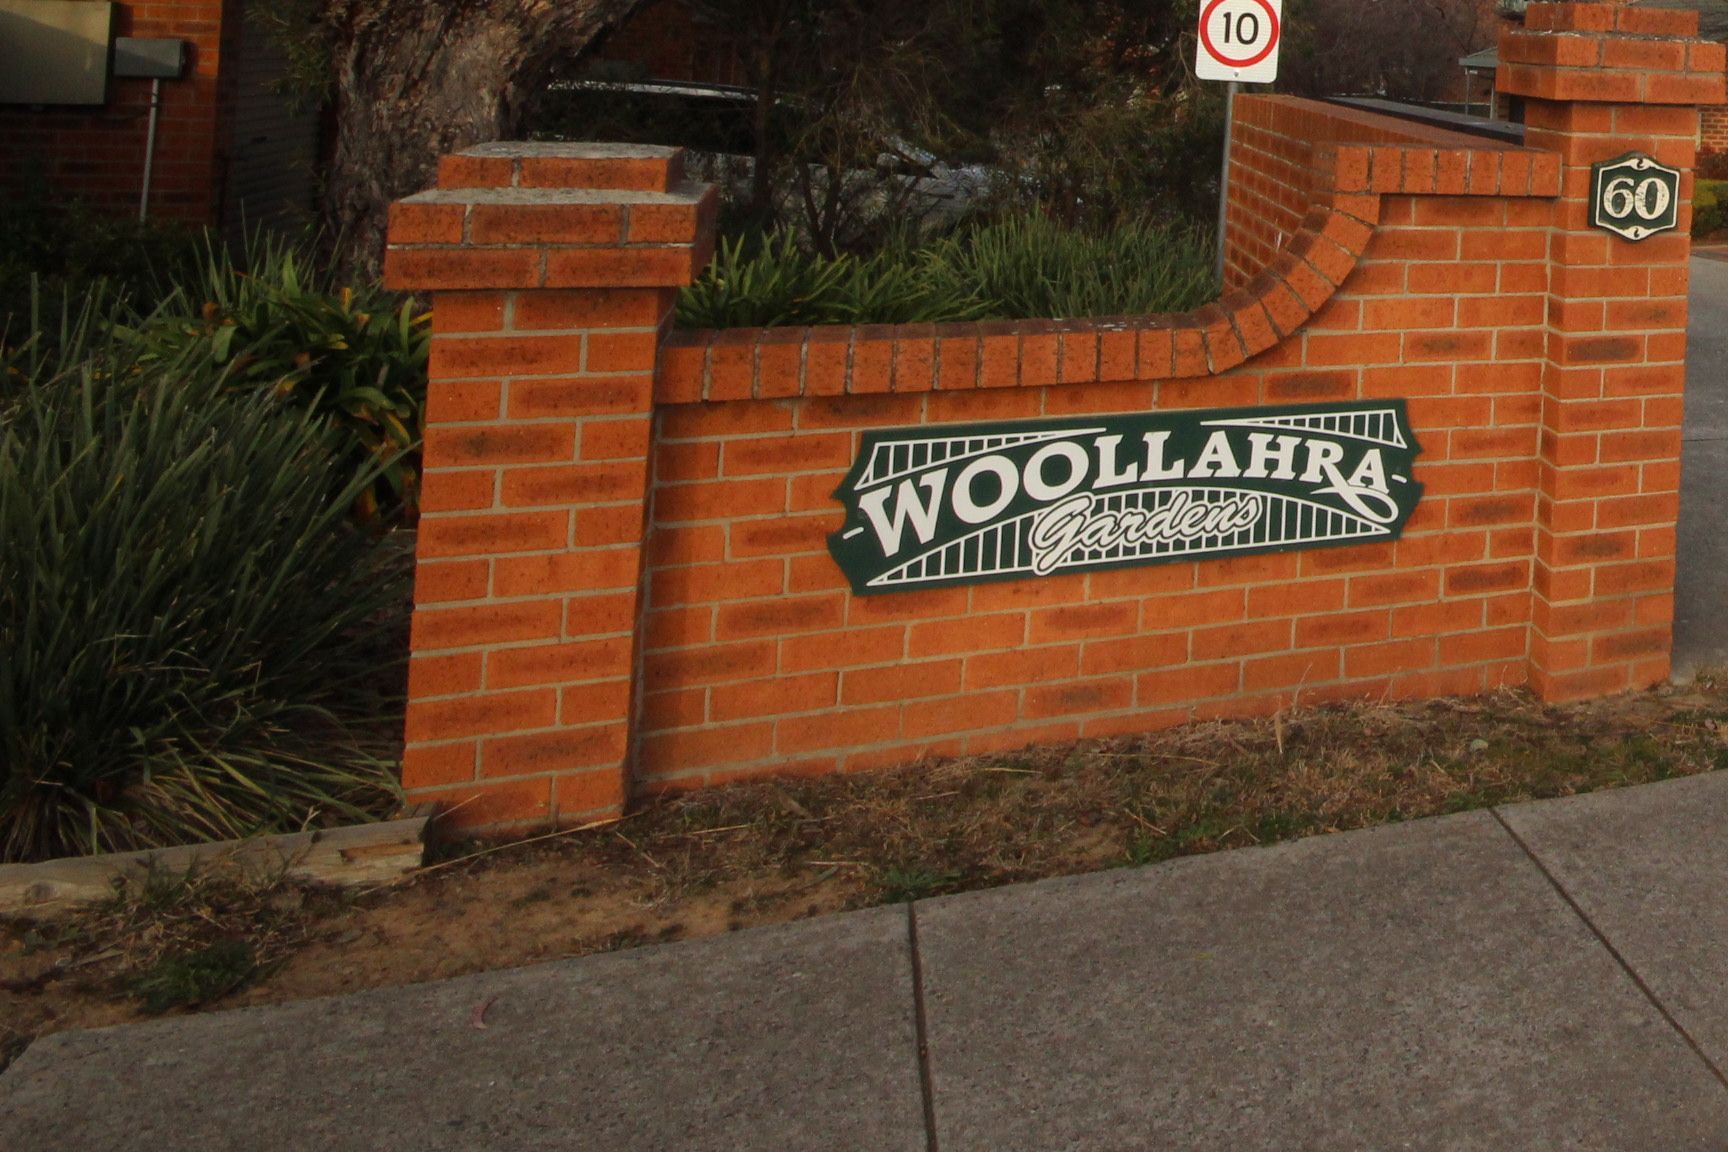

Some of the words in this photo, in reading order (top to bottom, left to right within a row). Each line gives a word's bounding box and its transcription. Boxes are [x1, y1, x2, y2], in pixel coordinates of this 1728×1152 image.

[1223, 11, 1259, 45] 10
[1603, 177, 1670, 220] 60
[858, 430, 1398, 557] WOOLLAHRA
[1031, 490, 1261, 573] Gardens
